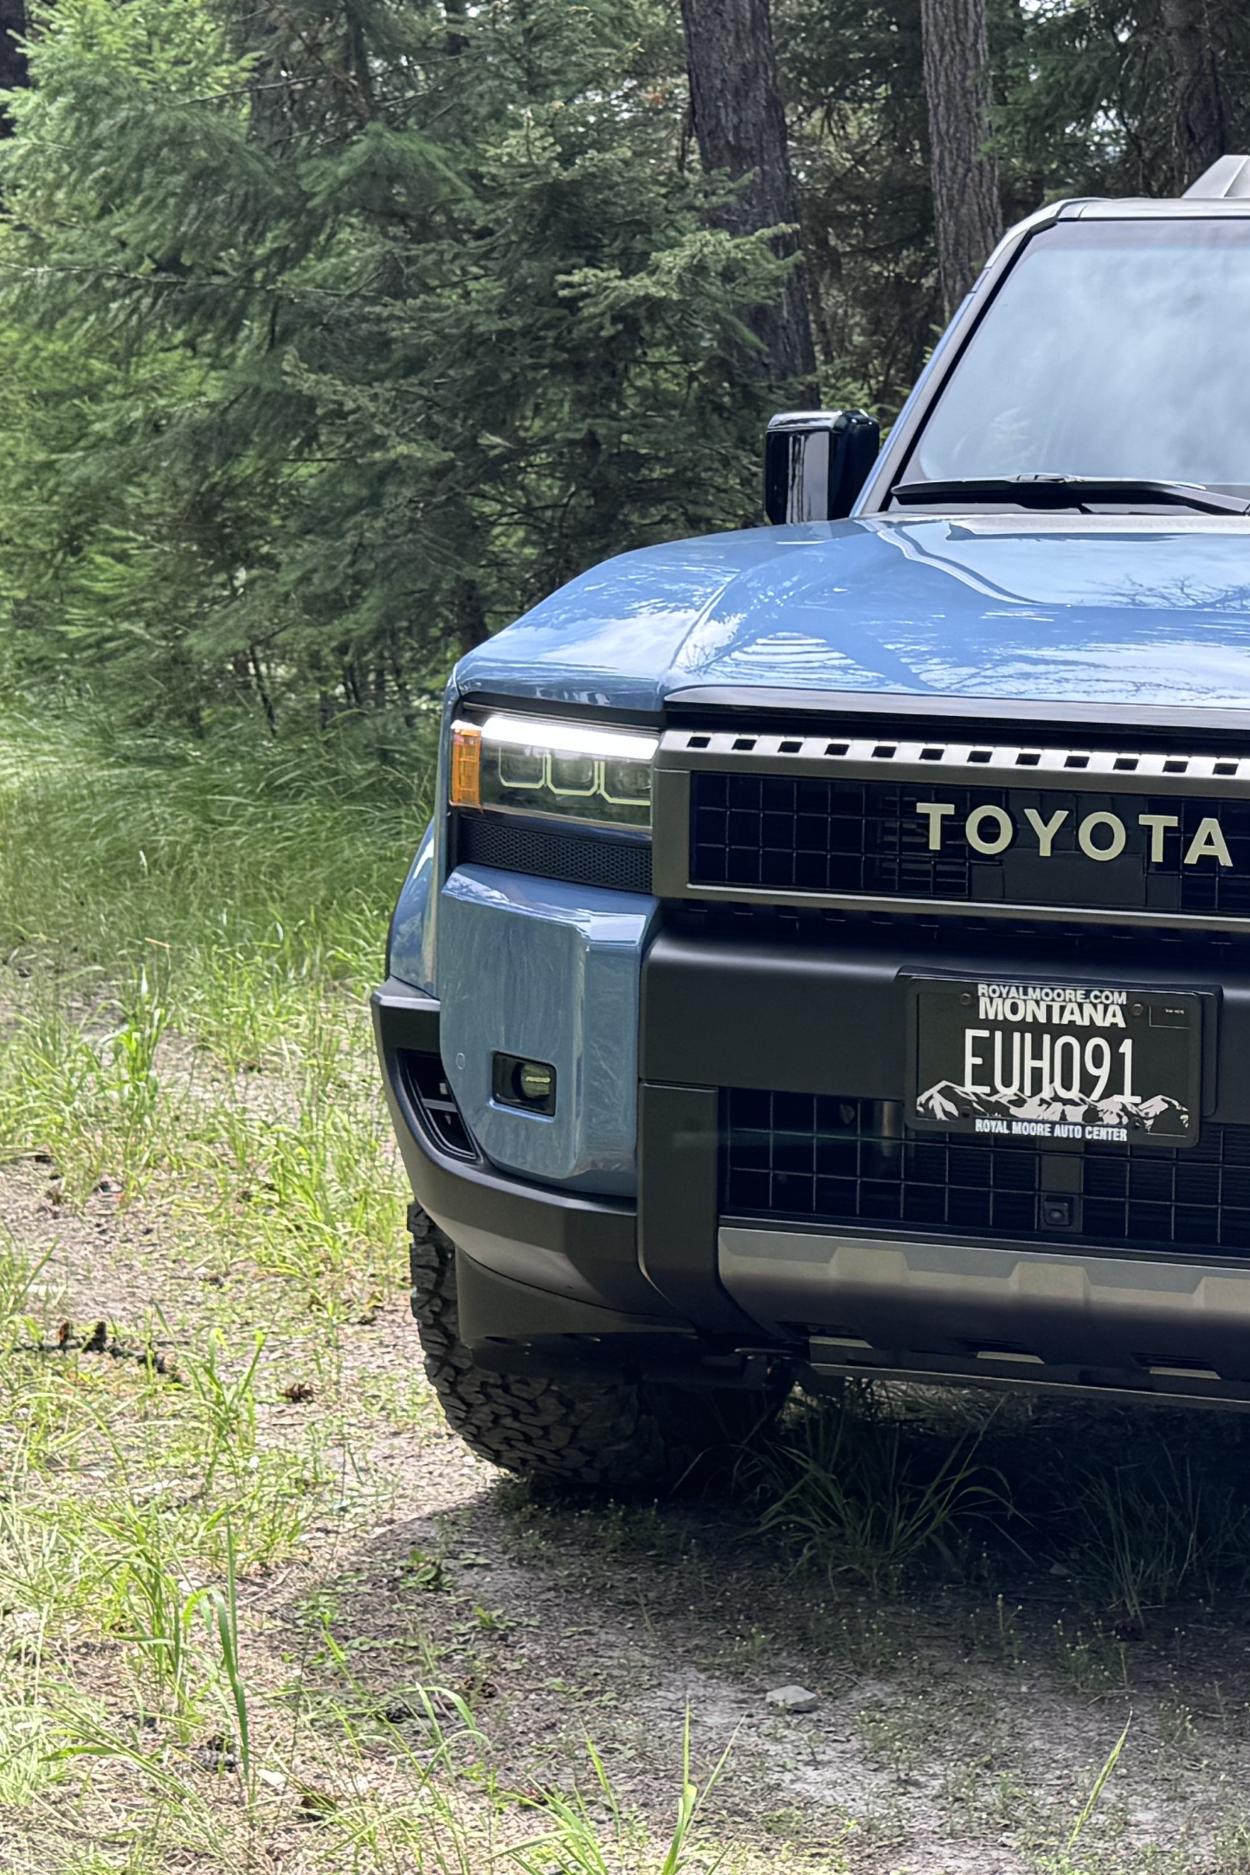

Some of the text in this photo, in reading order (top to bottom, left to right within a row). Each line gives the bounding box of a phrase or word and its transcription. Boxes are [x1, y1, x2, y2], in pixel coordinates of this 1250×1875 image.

[916, 802, 1233, 867] TOYOTA
[977, 983, 1127, 1005] ROYALMOORE.COM
[979, 997, 1127, 1028] MONTANA
[964, 1028, 1142, 1104] EUH091
[975, 1118, 1128, 1142] ROYAL MOORE AUTO CENTER
